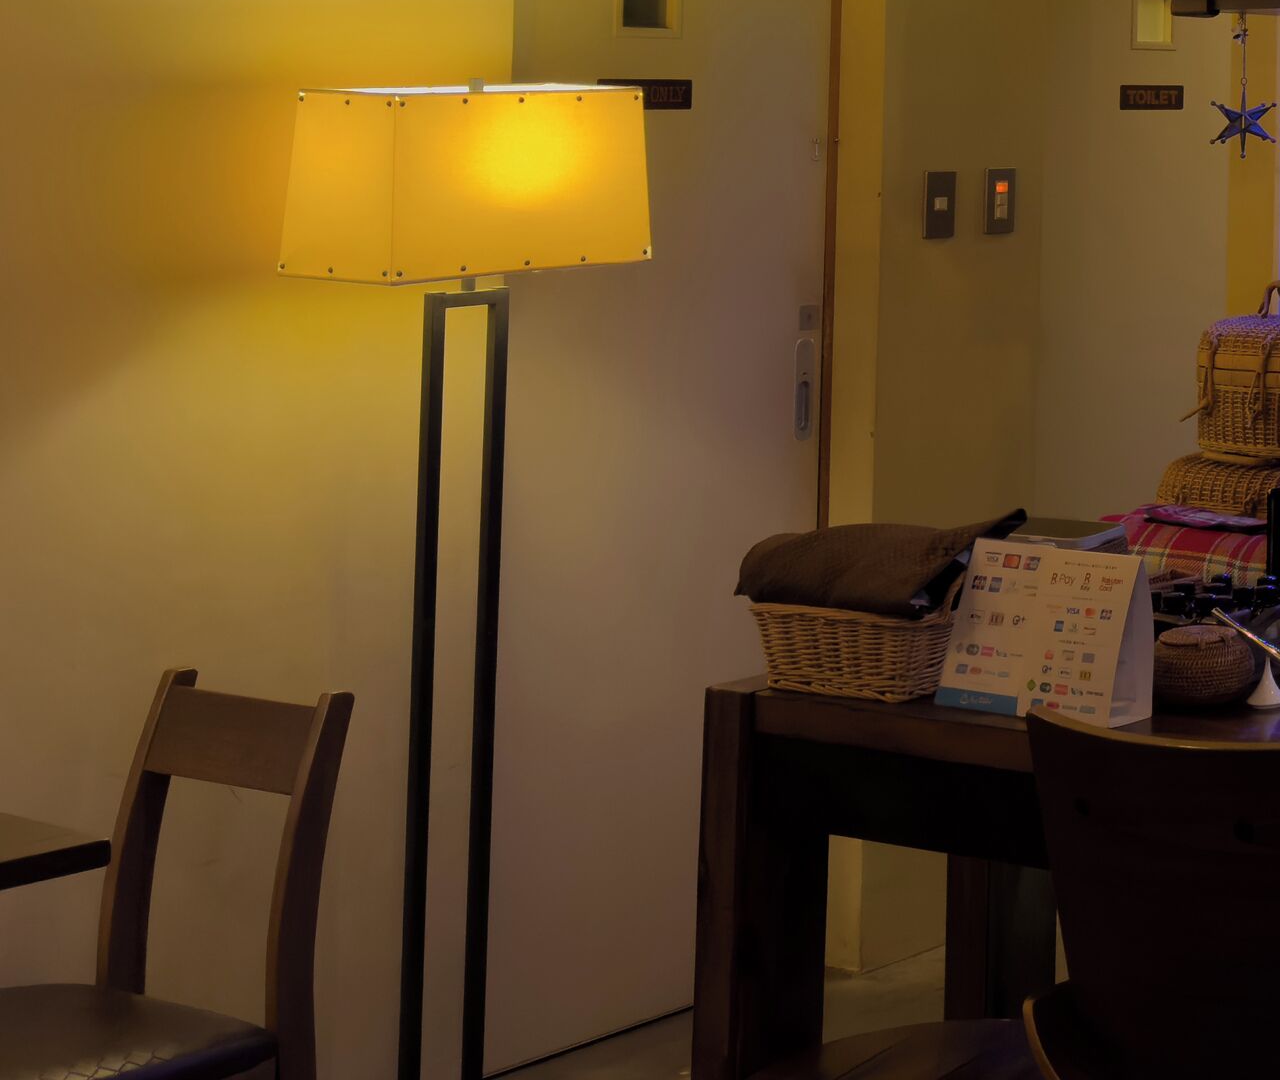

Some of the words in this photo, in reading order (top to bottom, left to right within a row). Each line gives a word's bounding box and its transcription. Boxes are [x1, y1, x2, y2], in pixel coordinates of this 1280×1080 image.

[650, 86, 687, 102] ONLY
[1126, 89, 1179, 104] TOILET
[1066, 607, 1080, 615] VISA
